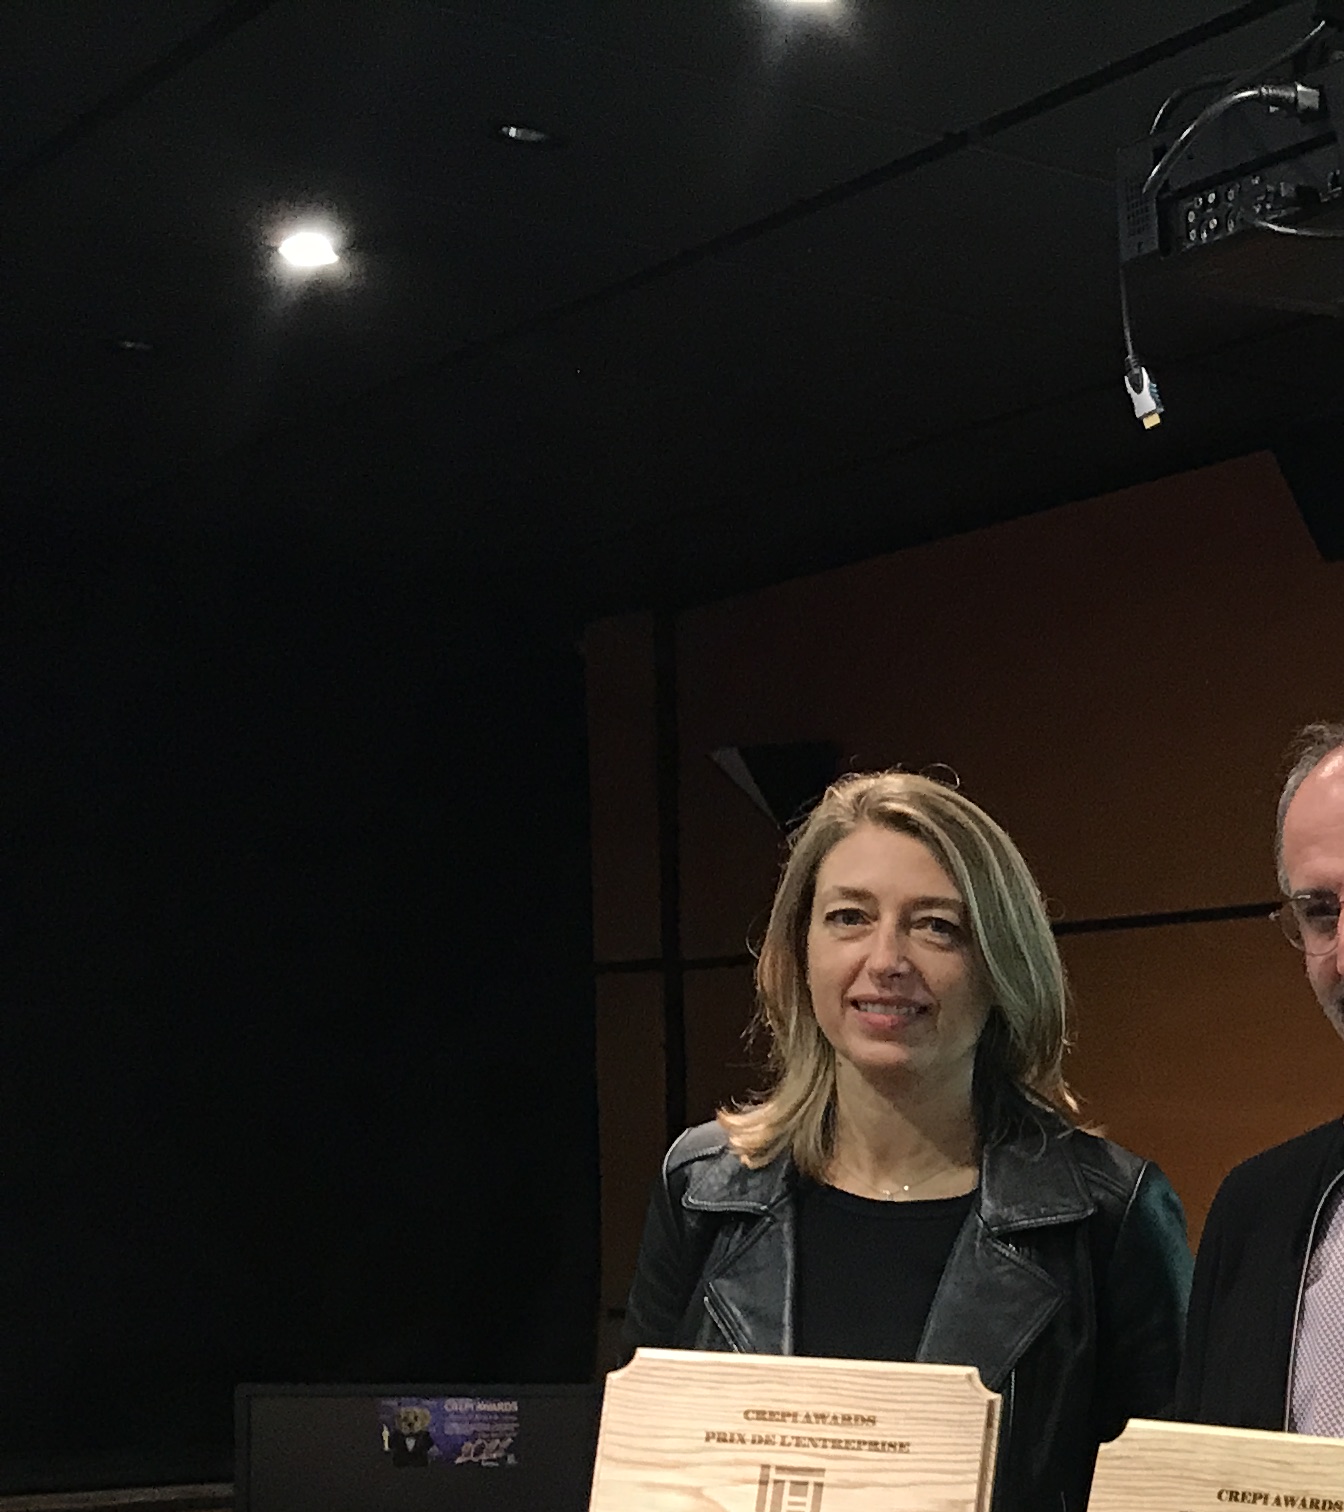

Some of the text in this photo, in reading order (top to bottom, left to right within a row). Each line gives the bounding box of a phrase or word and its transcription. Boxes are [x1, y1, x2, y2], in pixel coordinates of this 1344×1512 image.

[743, 1409, 877, 1427] CREPI AWARDS
[704, 1431, 911, 1454] PRIX DE L'ENTREPRISE
[1217, 1488, 1344, 1512] CREPI AWARDS
